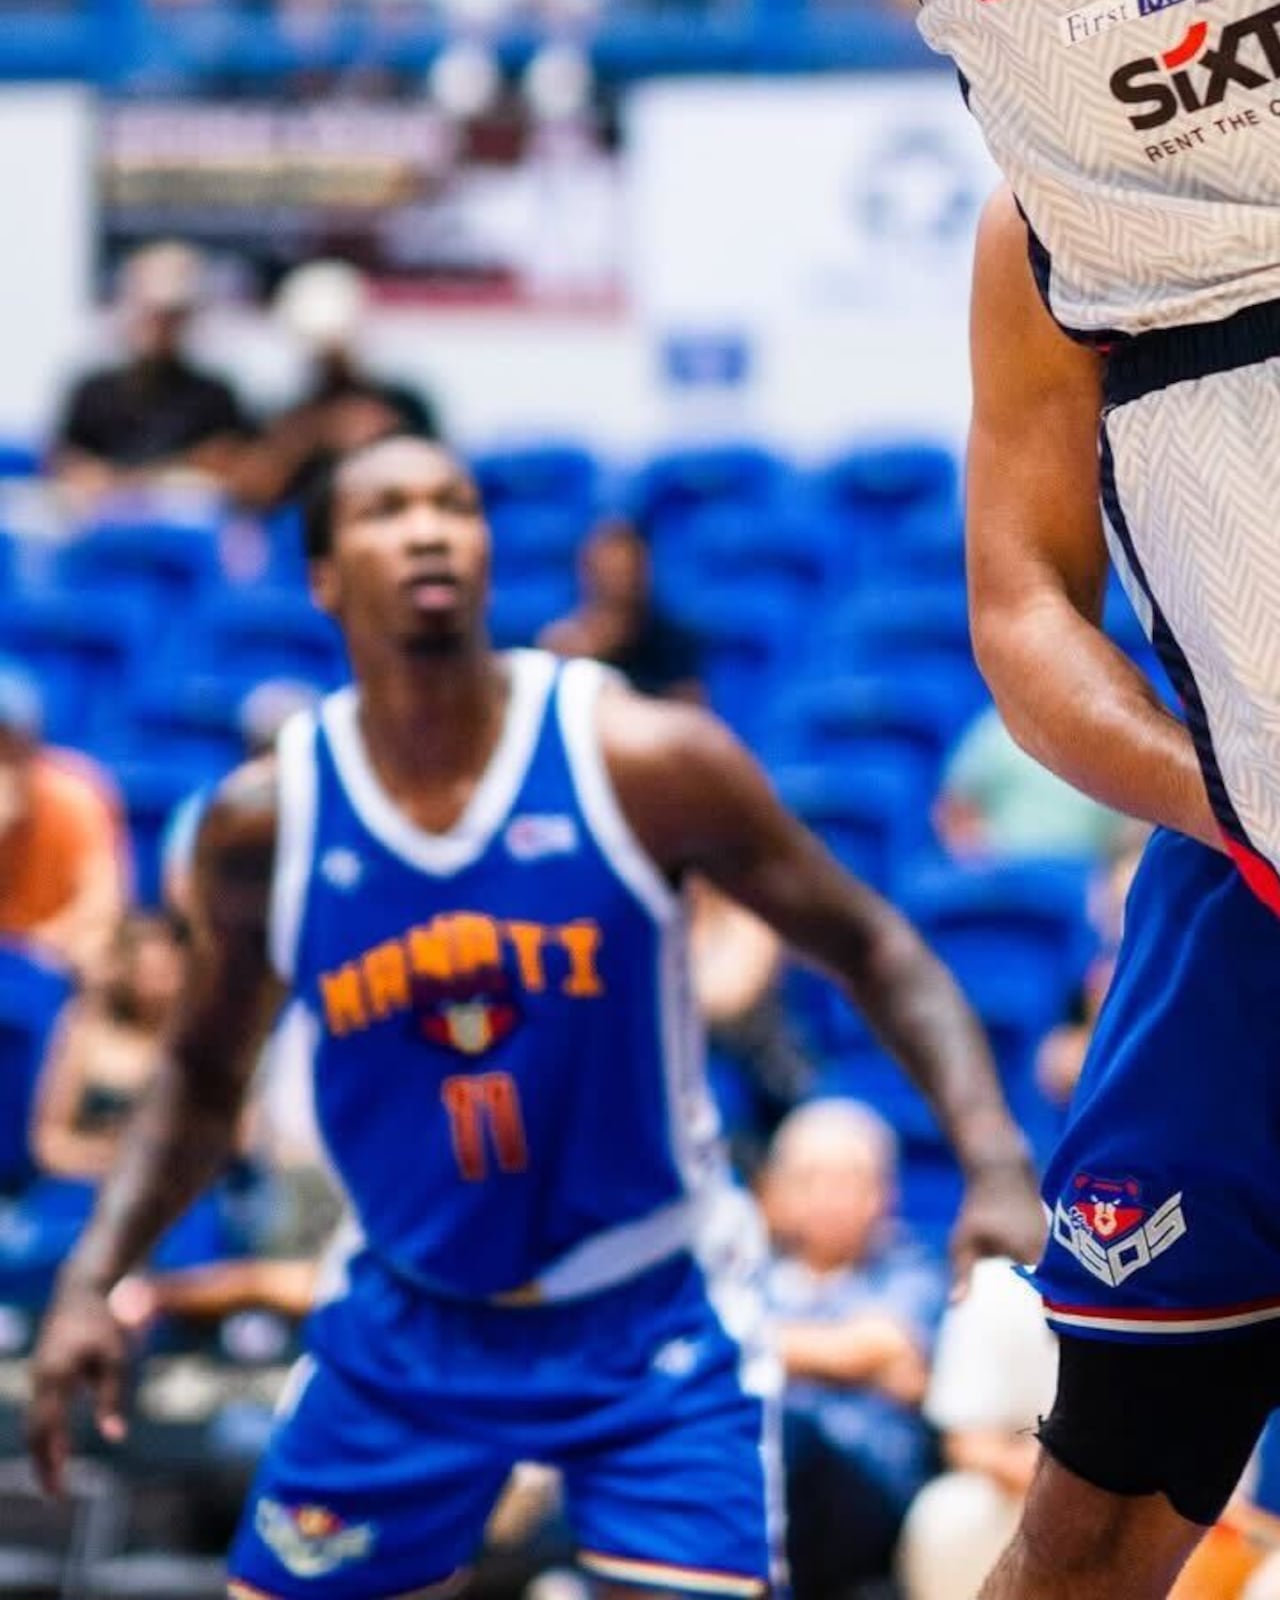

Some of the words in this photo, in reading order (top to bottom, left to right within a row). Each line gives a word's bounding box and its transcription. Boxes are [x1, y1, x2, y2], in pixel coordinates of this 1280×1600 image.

[1067, 3, 1128, 42] First
[1145, 127, 1204, 162] RENT
[1214, 109, 1260, 135] THE
[440, 1071, 529, 1182] 11
